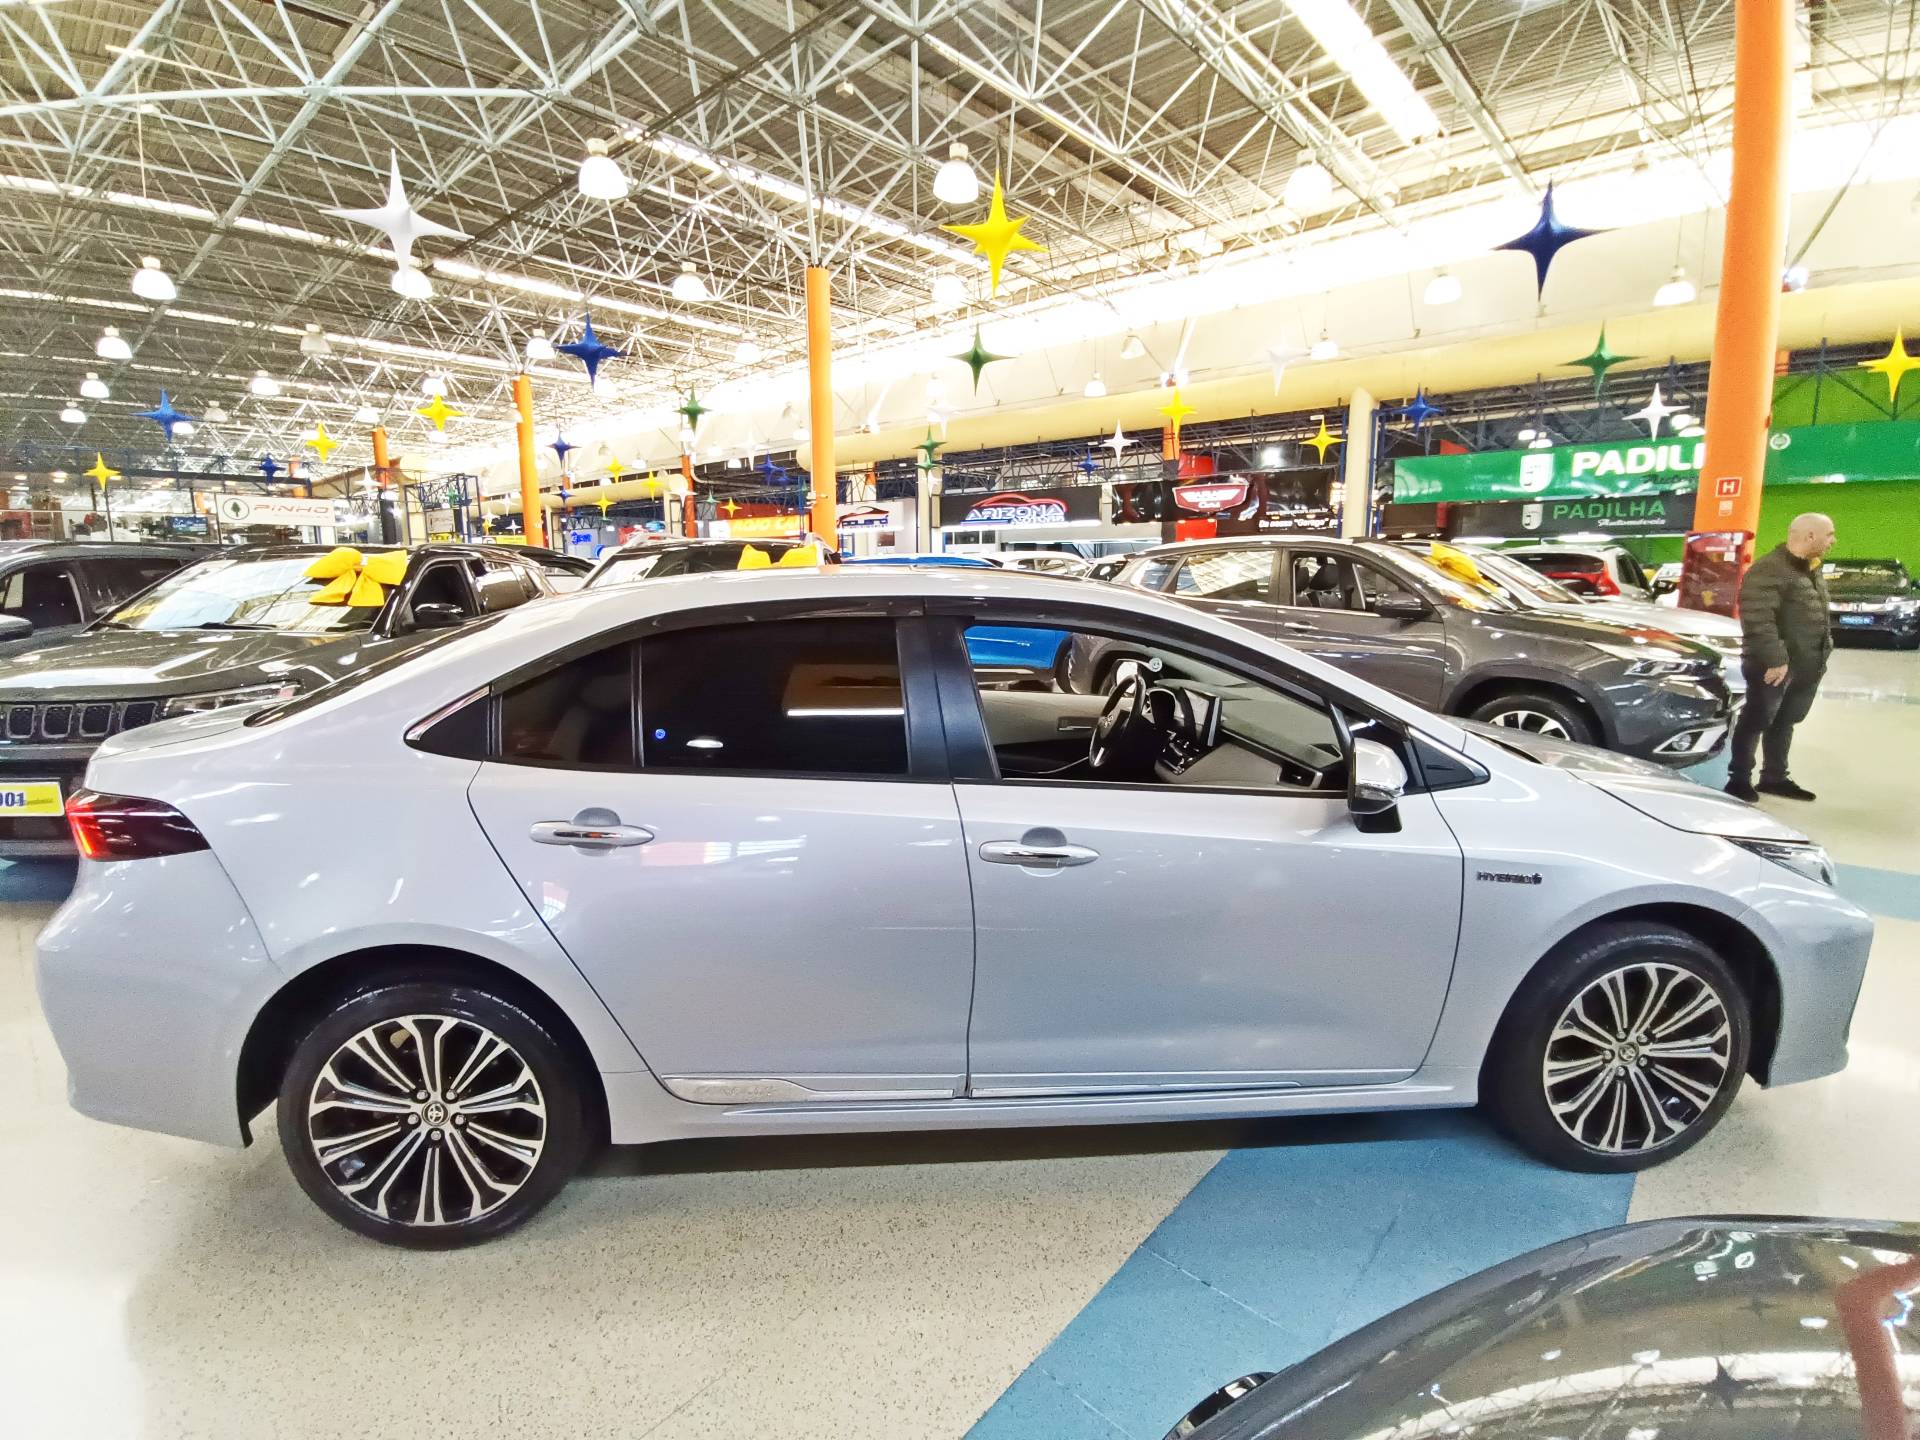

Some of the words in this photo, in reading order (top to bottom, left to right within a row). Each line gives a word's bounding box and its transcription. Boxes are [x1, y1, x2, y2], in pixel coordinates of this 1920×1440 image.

[1722, 481, 1735, 493] H
[965, 503, 1065, 521] ARIZONA
[1553, 500, 1666, 519] PADILHA
